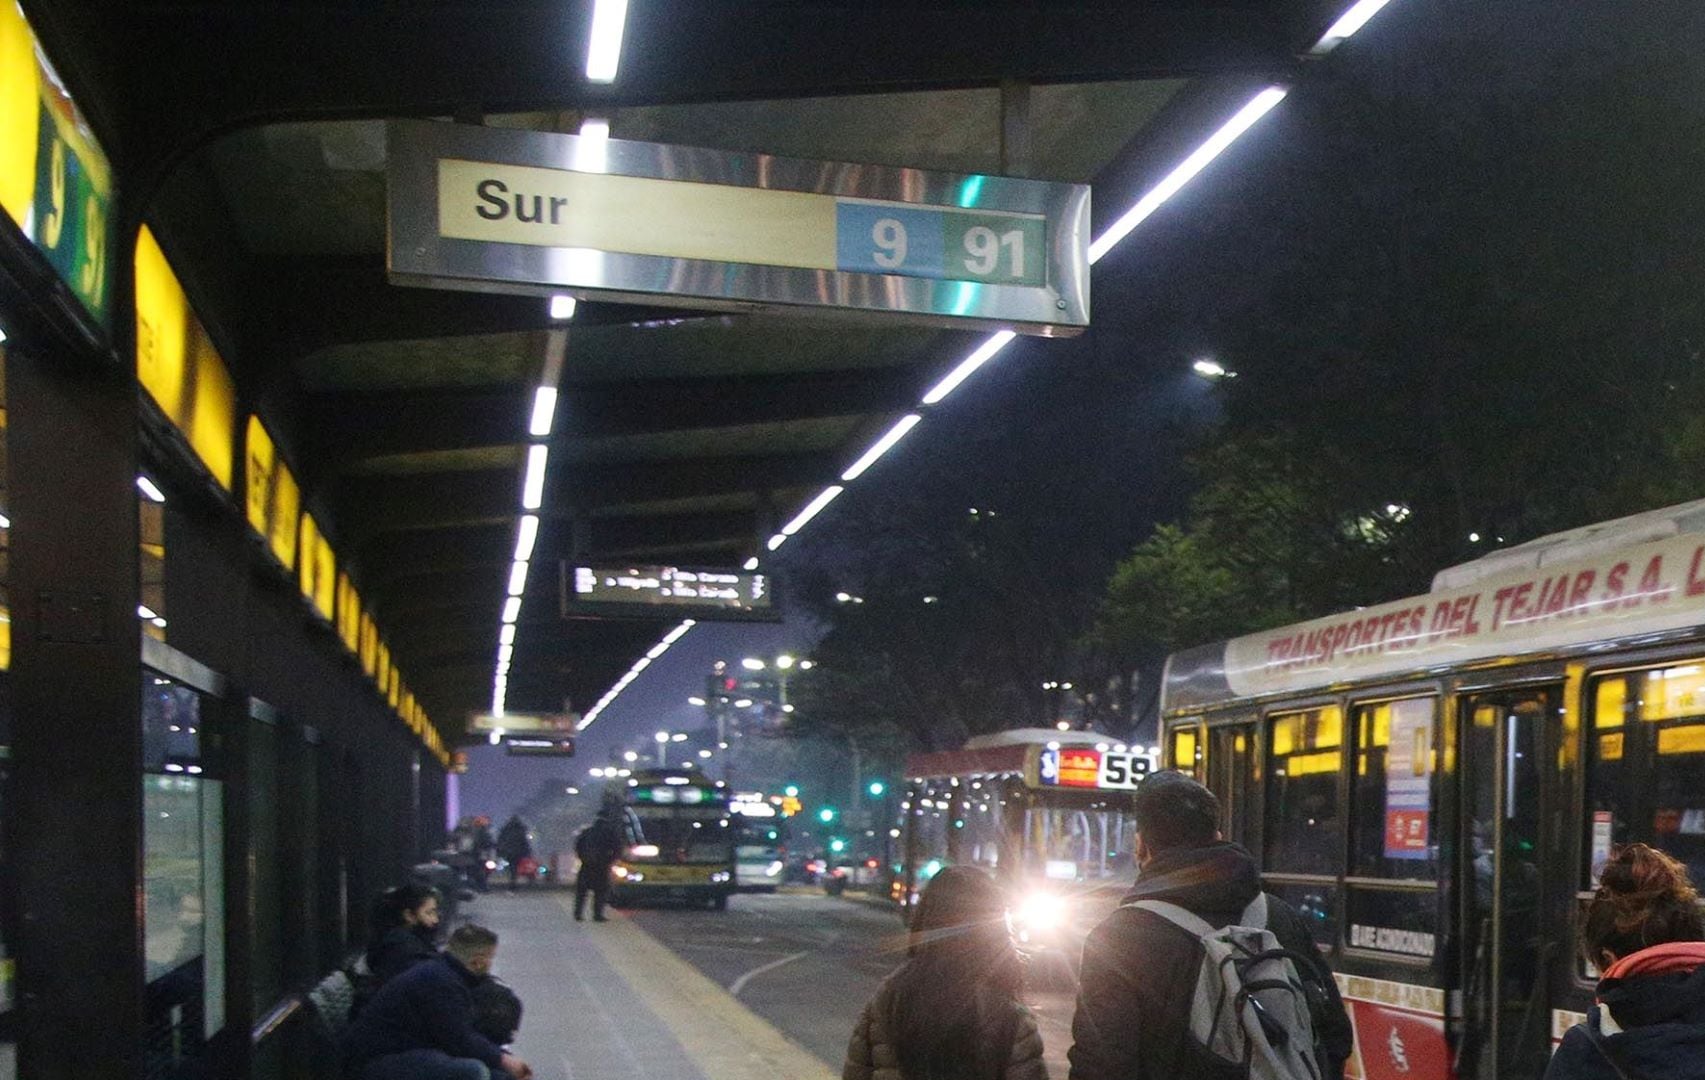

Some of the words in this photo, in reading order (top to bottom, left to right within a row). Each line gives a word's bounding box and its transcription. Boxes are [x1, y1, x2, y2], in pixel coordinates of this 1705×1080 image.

[475, 179, 568, 225] Sur
[872, 218, 907, 267] 9
[962, 226, 1026, 277] 91
[1266, 605, 1427, 672] TRANSPORTES
[1429, 592, 1481, 638] DEL
[1492, 570, 1597, 631] TEJAR
[1106, 755, 1151, 785] 59
